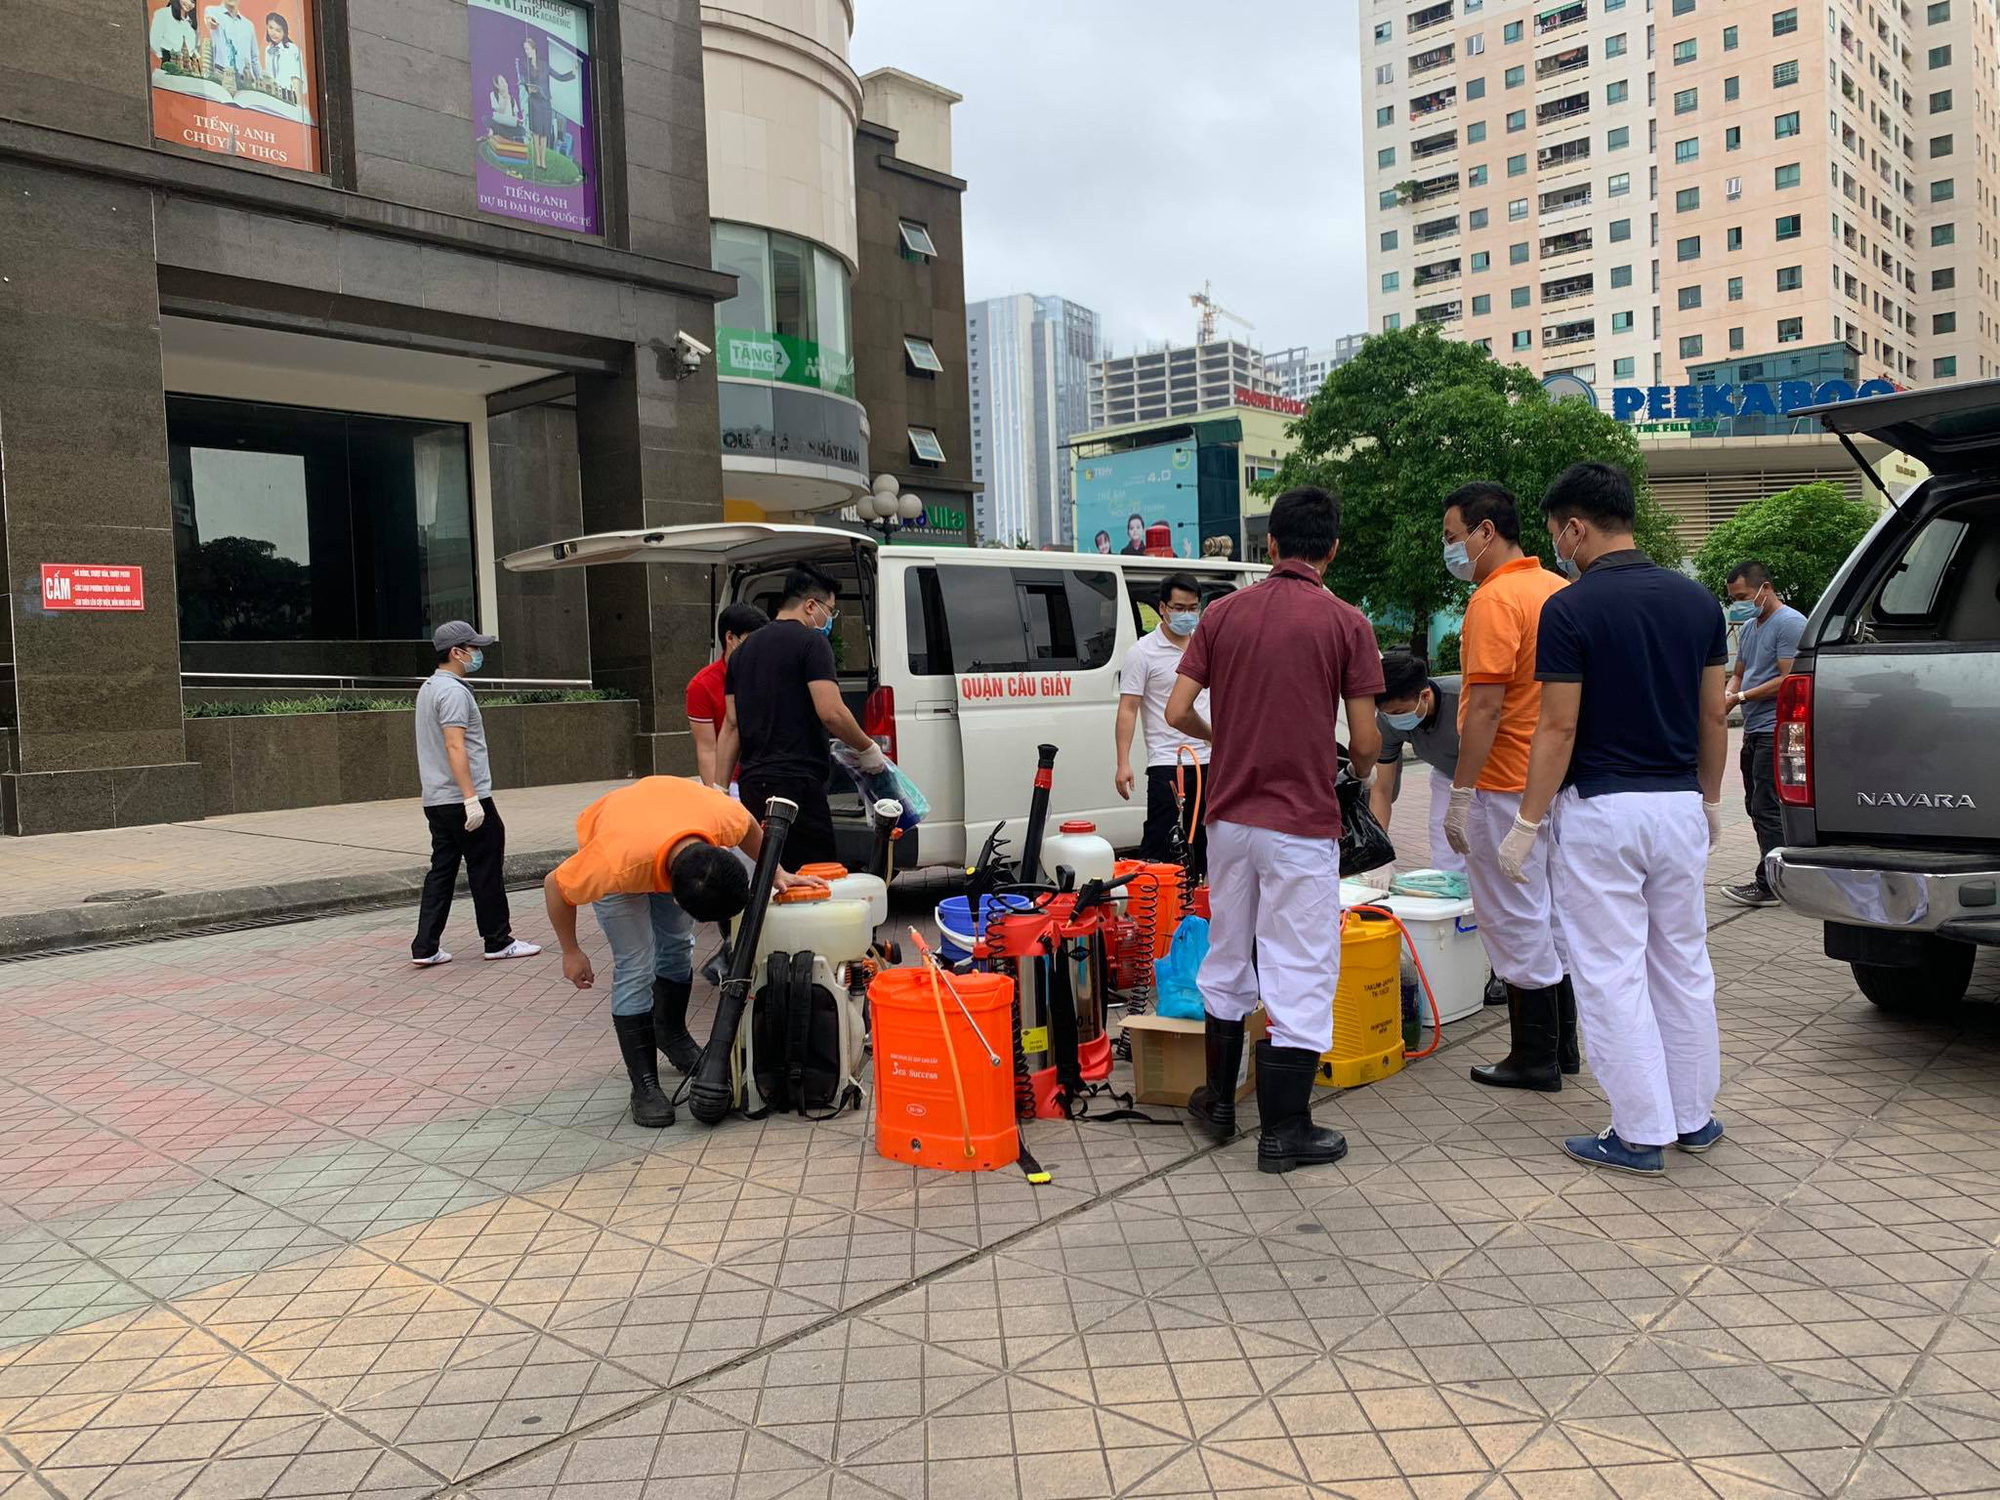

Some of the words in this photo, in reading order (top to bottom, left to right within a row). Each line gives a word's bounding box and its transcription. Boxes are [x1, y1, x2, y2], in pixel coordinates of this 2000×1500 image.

[513, 0, 540, 19] Link
[193, 114, 240, 136] TIẾNG
[244, 127, 276, 144] ANH
[183, 129, 247, 152] CHUYN
[249, 144, 288, 162] THCS
[503, 185, 540, 203] TIẾNG
[542, 195, 568, 209] ANH
[480, 194, 495, 207] DỰ
[497, 198, 508, 211] BỊ
[509, 203, 527, 214] ĐẠI
[530, 206, 550, 219] HỌC
[551, 211, 579, 224] QUỐC
[579, 216, 592, 228] TẾ
[776, 351, 783, 365] 2
[1147, 469, 1172, 483] 4.0
[45, 569, 71, 600] CẤM
[961, 672, 1003, 701] QUẬN
[1007, 671, 1037, 697] CẦU
[1041, 670, 1071, 697] GIẤY
[1856, 792, 1977, 809] NAVARA
